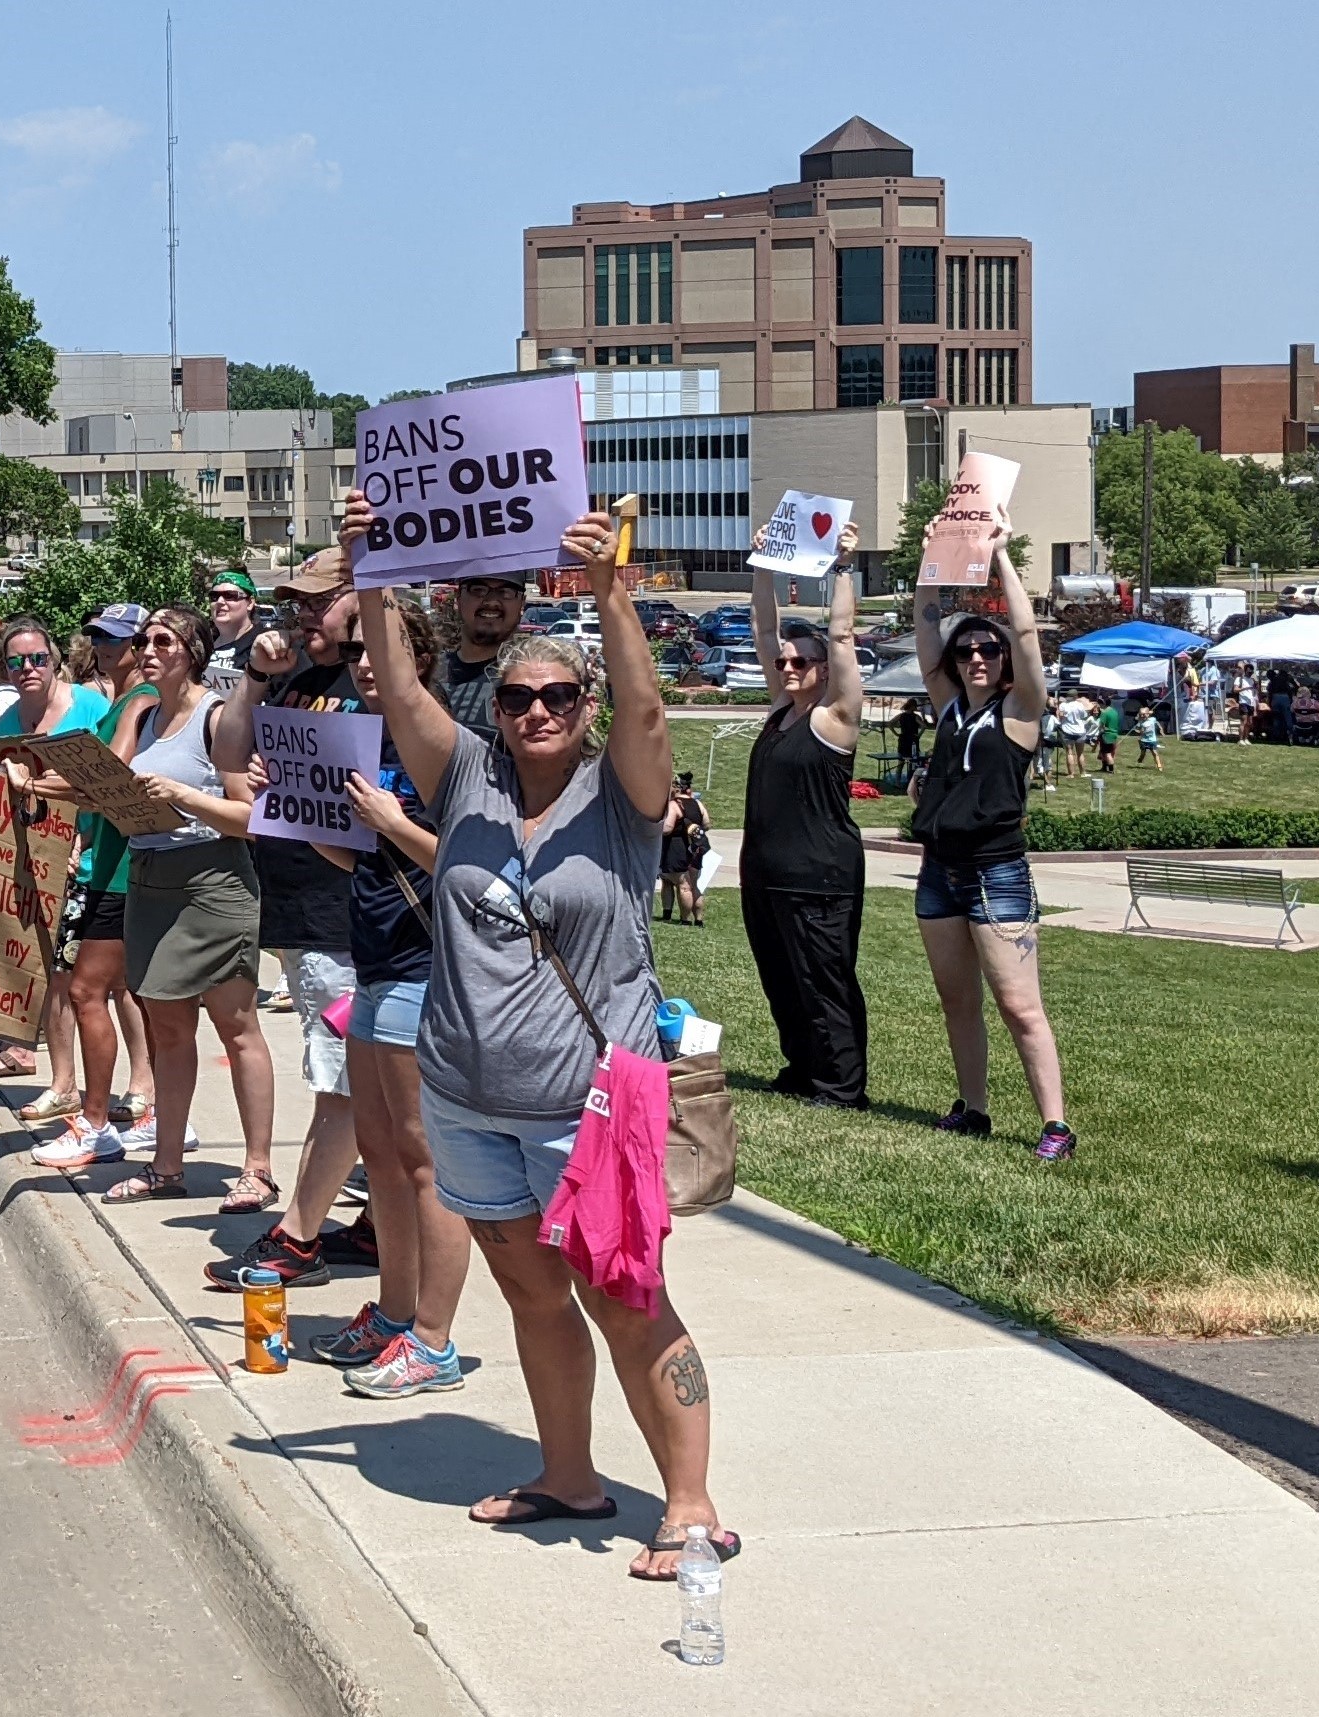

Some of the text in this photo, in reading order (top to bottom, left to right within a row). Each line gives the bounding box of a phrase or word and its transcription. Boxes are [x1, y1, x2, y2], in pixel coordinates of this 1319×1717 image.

[364, 414, 464, 465] BANS
[364, 448, 558, 508] OFF OUR
[950, 483, 981, 495] ODY.
[366, 496, 534, 552] BODIES
[261, 723, 318, 757] BANS
[266, 757, 305, 788] OFF
[30, 808, 74, 842] aughters
[262, 792, 352, 832] BODIES
[5, 938, 30, 968] my
